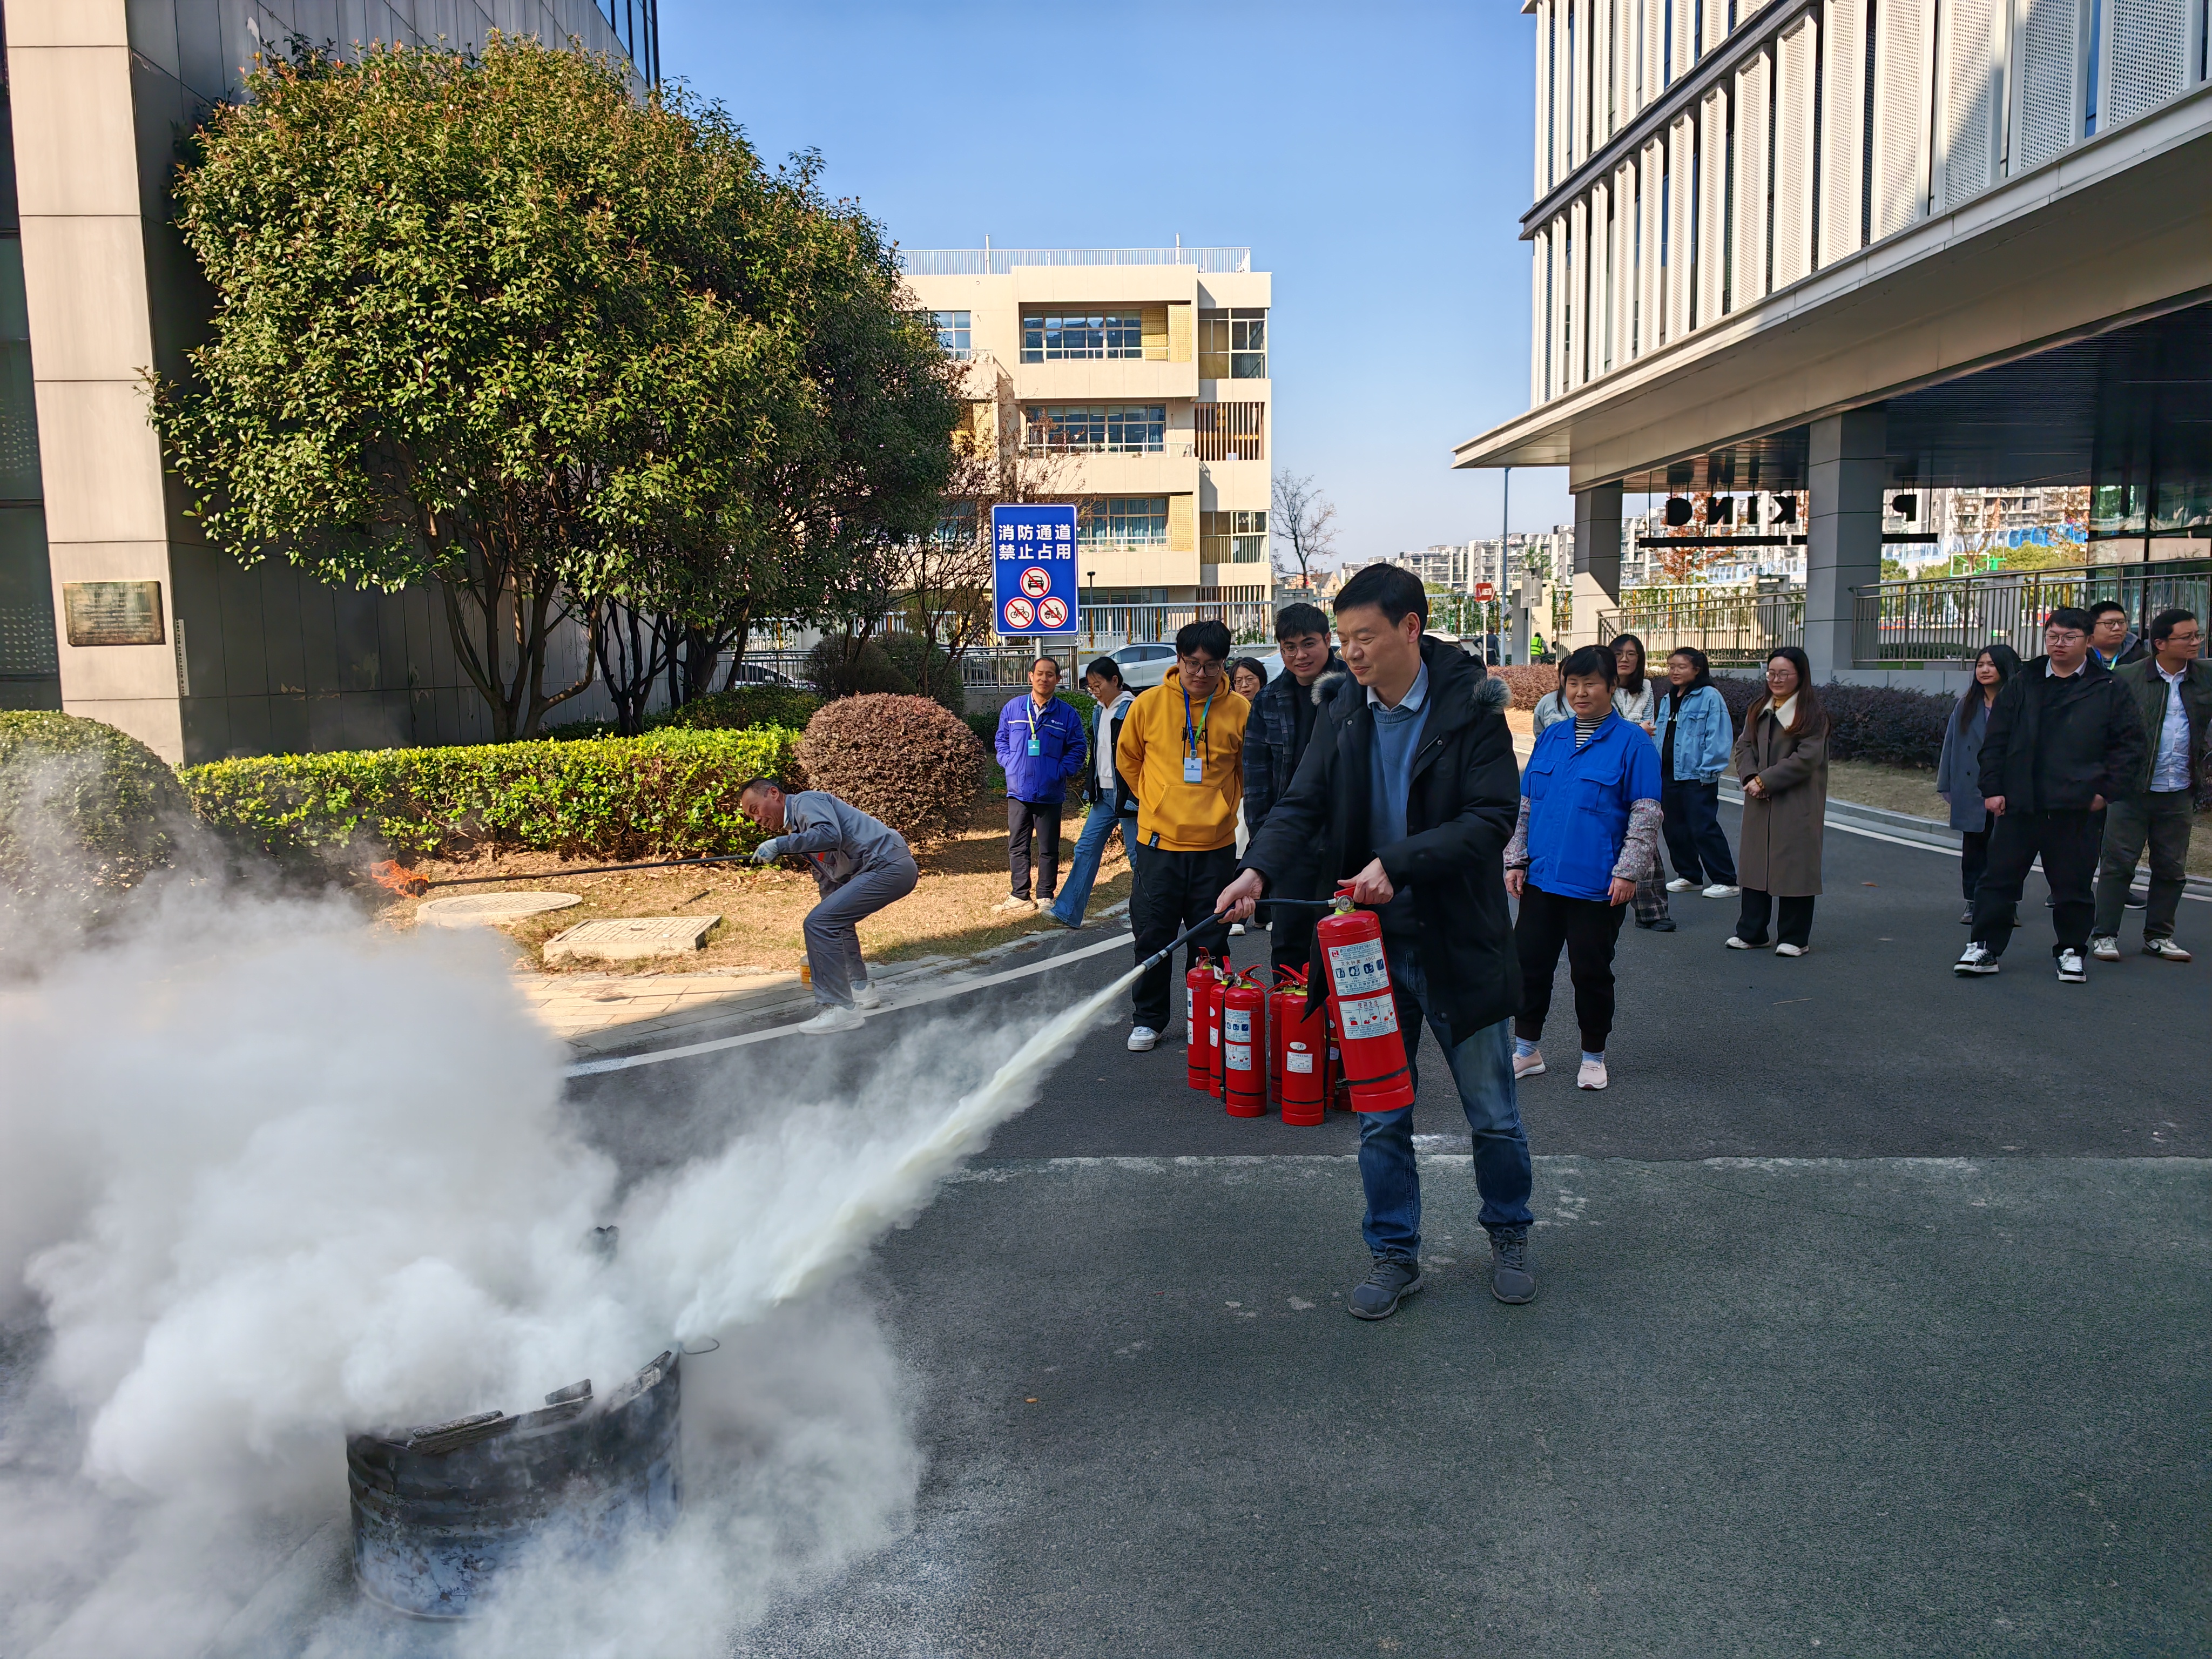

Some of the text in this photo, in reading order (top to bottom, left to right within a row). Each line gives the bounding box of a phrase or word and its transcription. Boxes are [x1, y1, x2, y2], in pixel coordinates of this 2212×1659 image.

[998, 524, 1071, 541] 消防通道
[998, 543, 1071, 560] 禁止占用
[1358, 1000, 1378, 1009] 使用方法
